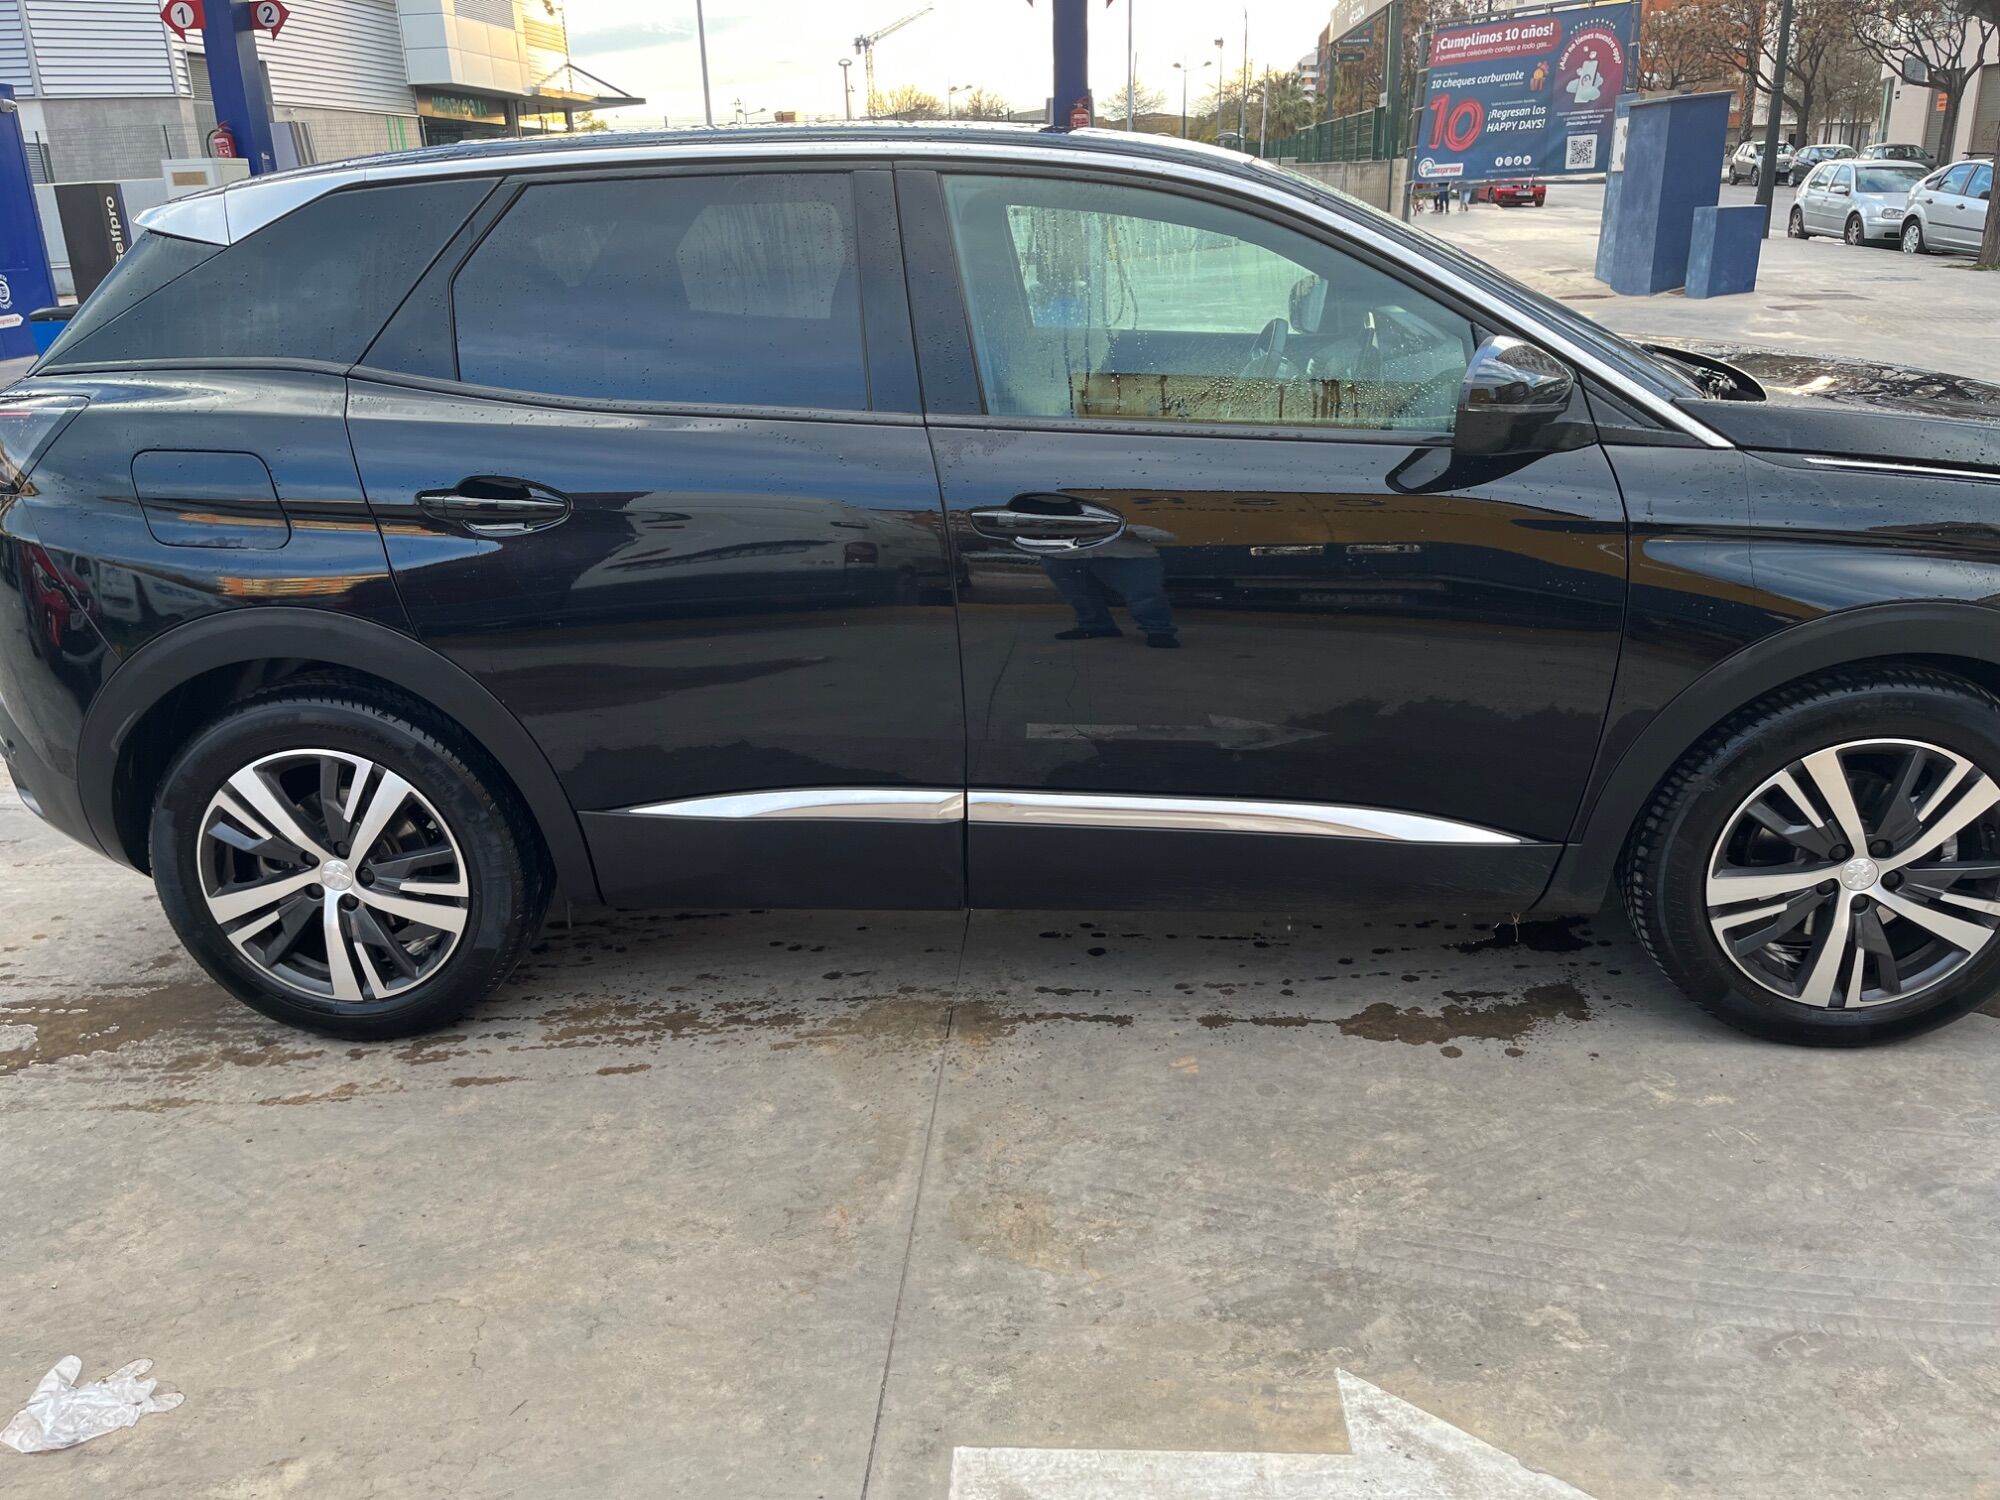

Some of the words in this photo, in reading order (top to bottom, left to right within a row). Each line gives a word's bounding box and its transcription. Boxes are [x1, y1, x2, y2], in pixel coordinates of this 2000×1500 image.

[177, 7, 186, 25] 1
[262, 6, 275, 23] 2
[1436, 31, 1503, 53] ¡Cumplimos
[1504, 27, 1519, 41] 10
[1521, 22, 1554, 39] años!
[1431, 79, 1442, 89] 10
[1442, 76, 1476, 89] cheques
[1476, 70, 1525, 85] carburante
[1487, 107, 1531, 121] ¡Regresan
[1531, 104, 1547, 115] los
[1428, 92, 1485, 153] 10
[1486, 120, 1518, 133] HAPPY
[1518, 118, 1547, 130] DAYS!
